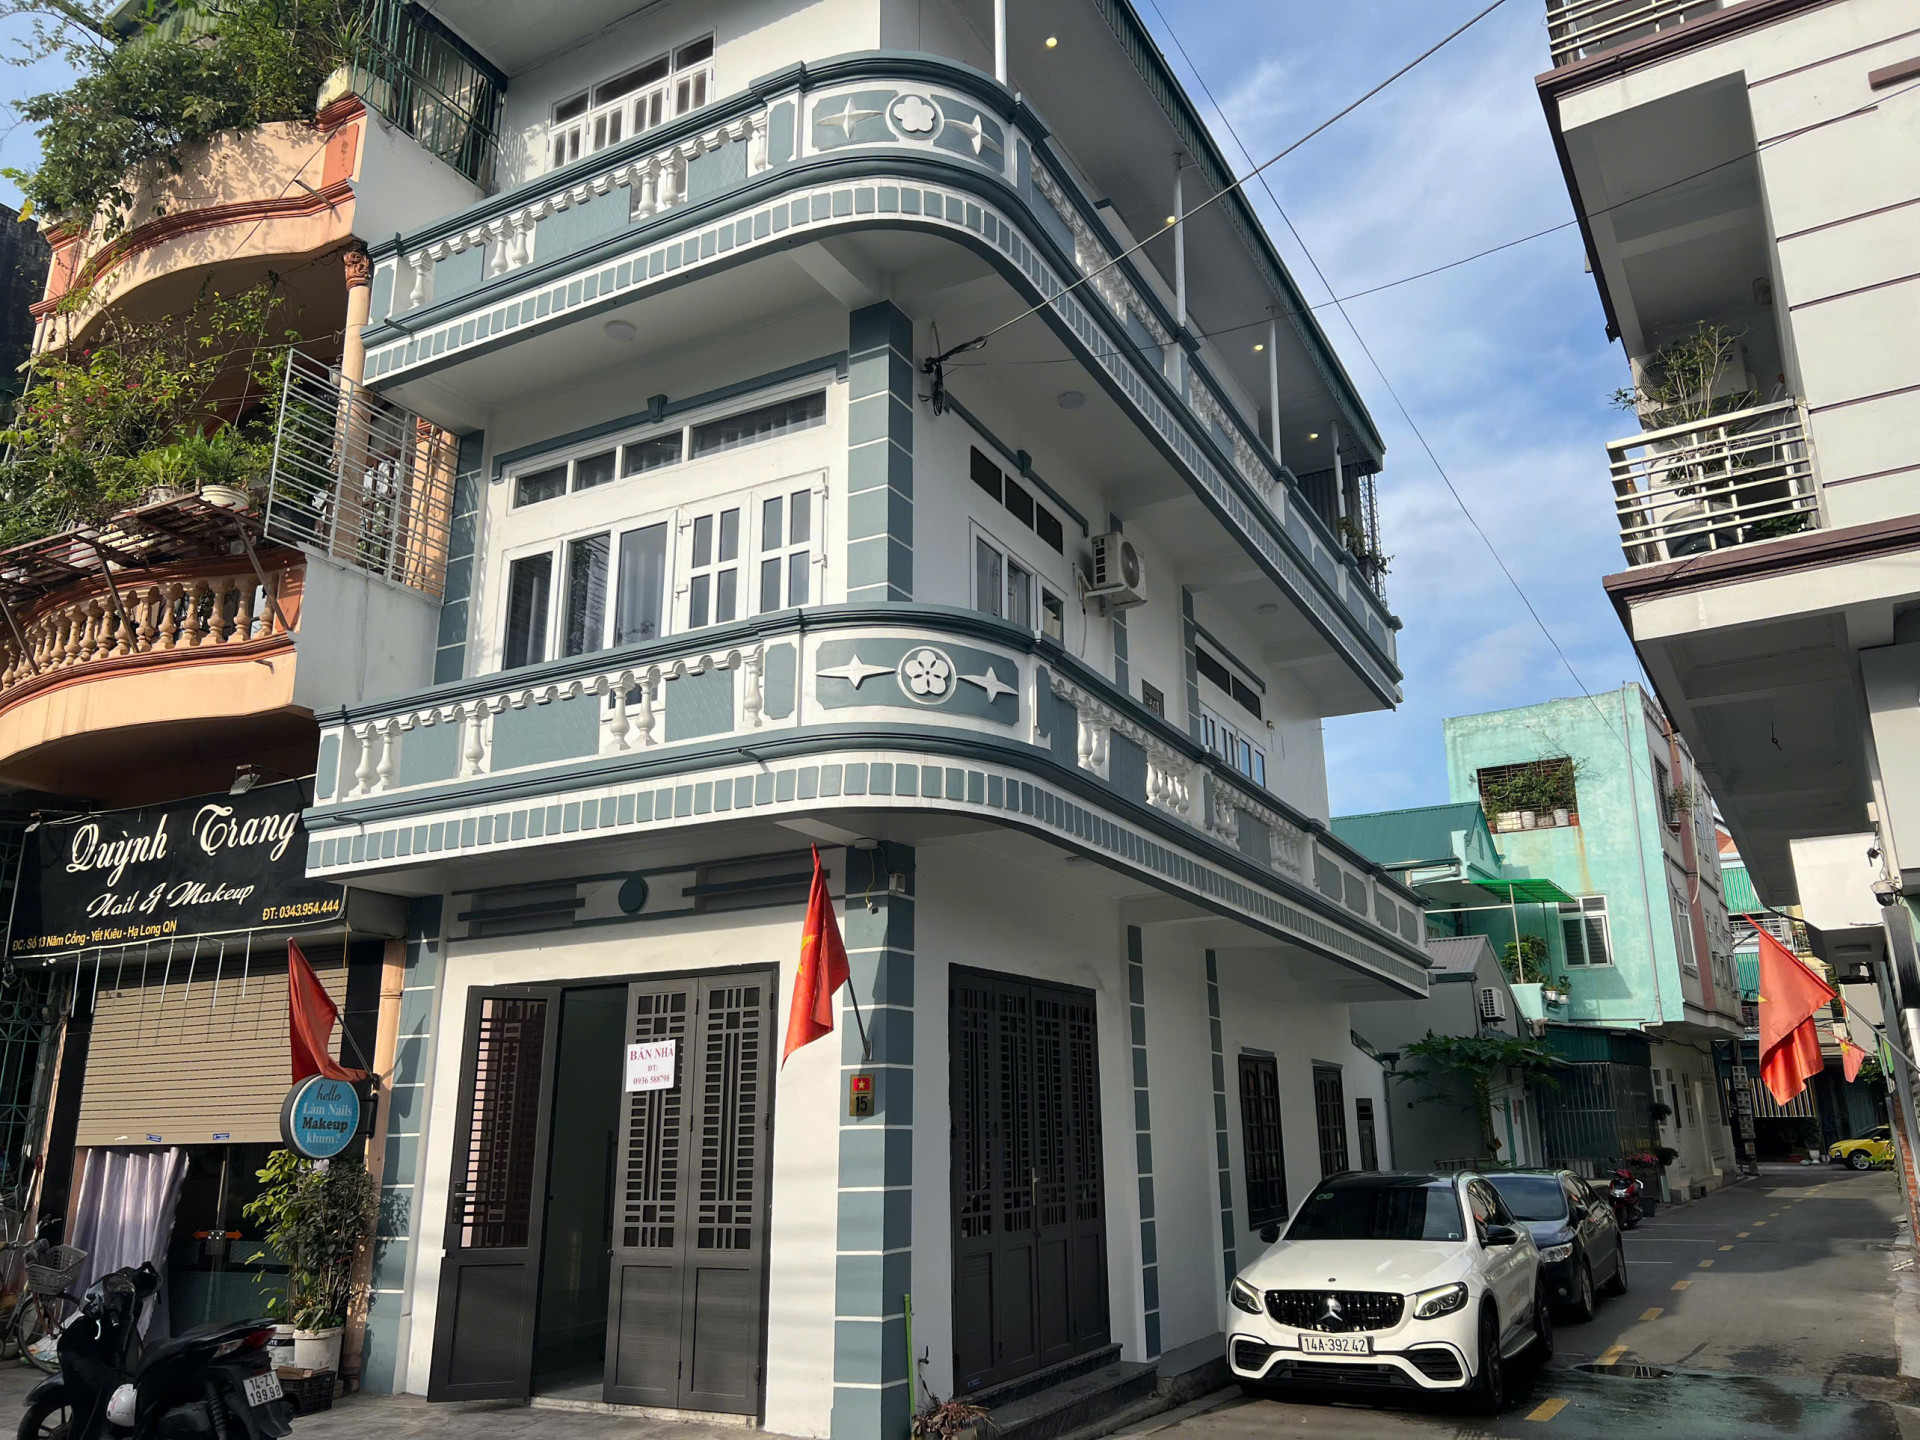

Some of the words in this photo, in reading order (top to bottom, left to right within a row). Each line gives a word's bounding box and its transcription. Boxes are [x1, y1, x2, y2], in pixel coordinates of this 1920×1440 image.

[66, 813, 168, 887] Quỳnh
[192, 803, 300, 862] Trang
[86, 890, 140, 918] Nail
[138, 882, 167, 915] &
[166, 880, 255, 908] Makeup
[262, 907, 278, 921] ĐT:
[279, 899, 340, 918] 0343.954.444
[38, 936, 46, 948] 13
[46, 935, 64, 947] Năm
[127, 925, 139, 939] Hạ
[140, 923, 162, 937] Long
[162, 920, 177, 933] QN
[630, 1047, 652, 1061] BÁN
[655, 1043, 674, 1059] NHÀ
[633, 1076, 649, 1085] 0936
[317, 1083, 342, 1101] hello
[303, 1102, 326, 1115] Làm
[328, 1103, 353, 1117] Nails
[855, 1095, 868, 1112] 15
[302, 1116, 348, 1134] Makeup
[306, 1131, 341, 1144] khum?
[249, 1373, 274, 1391] 14-Z1
[250, 1384, 281, 1405] 199.98
